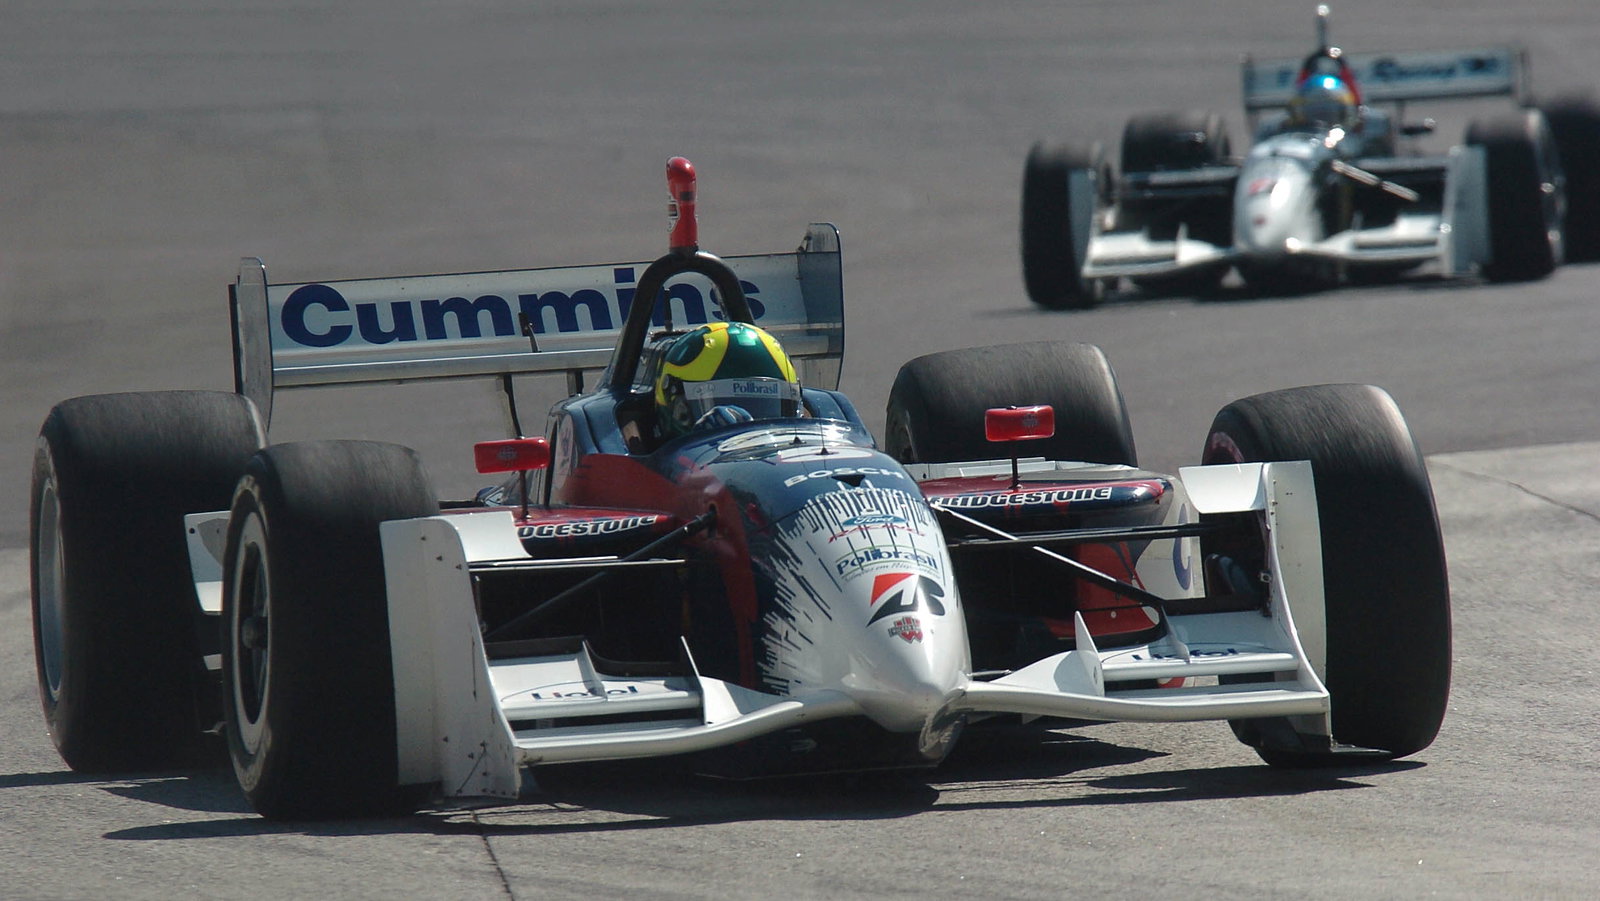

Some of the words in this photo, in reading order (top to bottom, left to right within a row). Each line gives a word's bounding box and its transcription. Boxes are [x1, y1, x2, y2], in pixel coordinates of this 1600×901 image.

[281, 267, 766, 347] Cummins
[733, 381, 778, 394] Polibrasil
[783, 467, 904, 487] BOSCH
[517, 515, 658, 539] DGESTONE
[854, 515, 895, 524] Ford
[836, 548, 938, 575] Polibrasil
